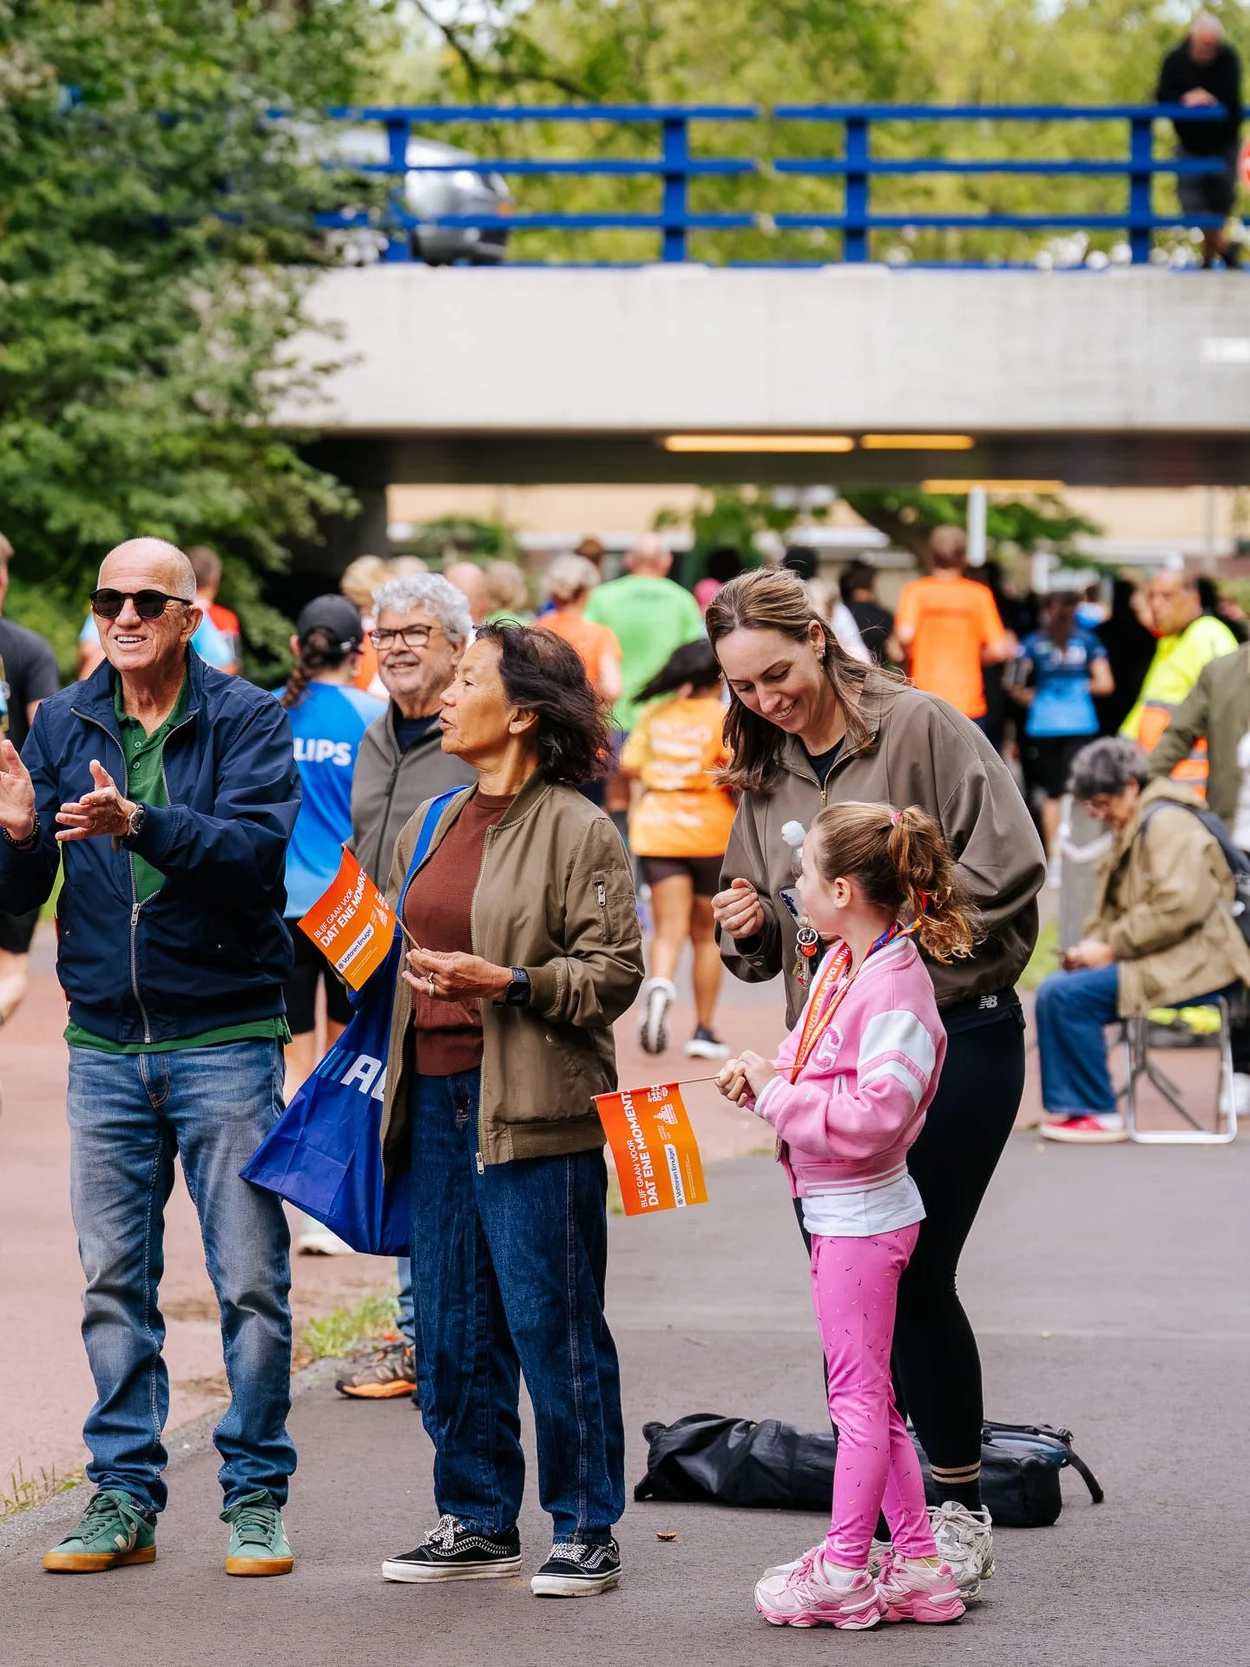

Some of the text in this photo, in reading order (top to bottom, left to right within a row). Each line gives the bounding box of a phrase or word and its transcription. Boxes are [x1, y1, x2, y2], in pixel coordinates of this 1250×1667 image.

[293, 737, 352, 767] LIPS
[313, 888, 354, 939] BLIJF GAAN VOOR
[319, 924, 341, 948] DAT
[337, 904, 356, 928] ENE
[342, 943, 359, 964] Voltaren
[357, 927, 372, 948] Emulgel
[834, 946, 851, 966] MINI
[626, 1139, 648, 1208] BLIJF GAAN VOOR
[639, 1151, 654, 1178] ENE
[667, 1147, 682, 1197] Voltaren Emulgel
[645, 1181, 659, 1206] DAT
